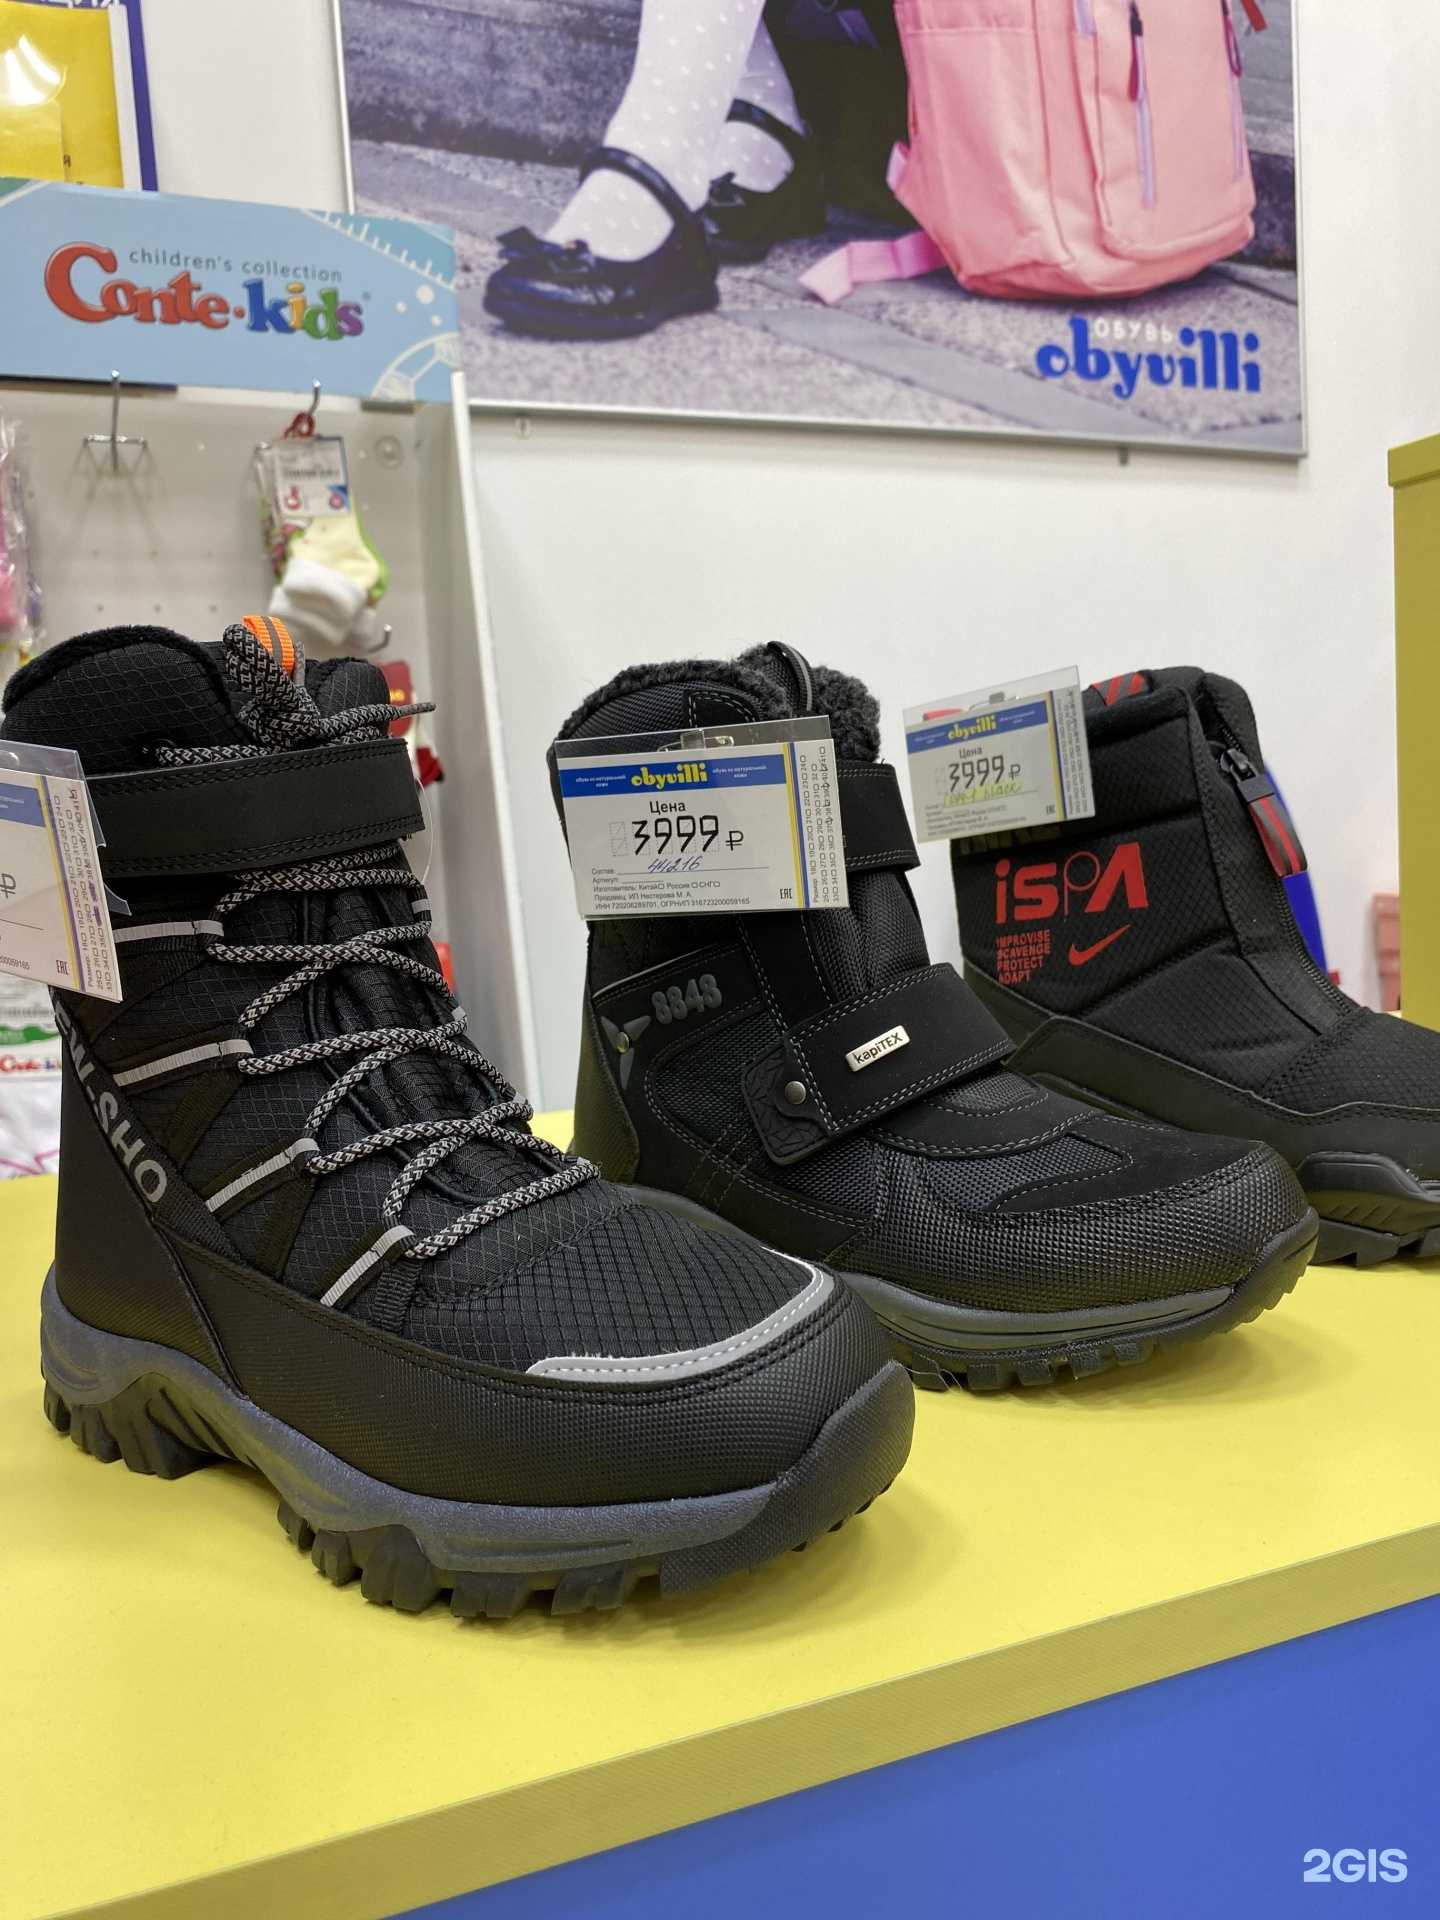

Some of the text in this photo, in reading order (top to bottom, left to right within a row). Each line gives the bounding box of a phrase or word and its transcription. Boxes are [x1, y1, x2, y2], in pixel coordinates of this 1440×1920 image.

[129, 248, 343, 283] children's collection
[1093, 316, 1173, 343] ОБУВЬ
[1035, 314, 1261, 400] obyvilli
[958, 747, 983, 760] Цена
[631, 762, 708, 790] obyvilli
[948, 754, 1005, 792] 3999
[650, 800, 686, 814] Цена
[631, 815, 720, 855] 3999
[996, 929, 1050, 948] IMPROVISE
[996, 956, 1044, 972] PROTECT
[651, 973, 722, 1025] 8848
[853, 1031, 904, 1065] kapiTEX
